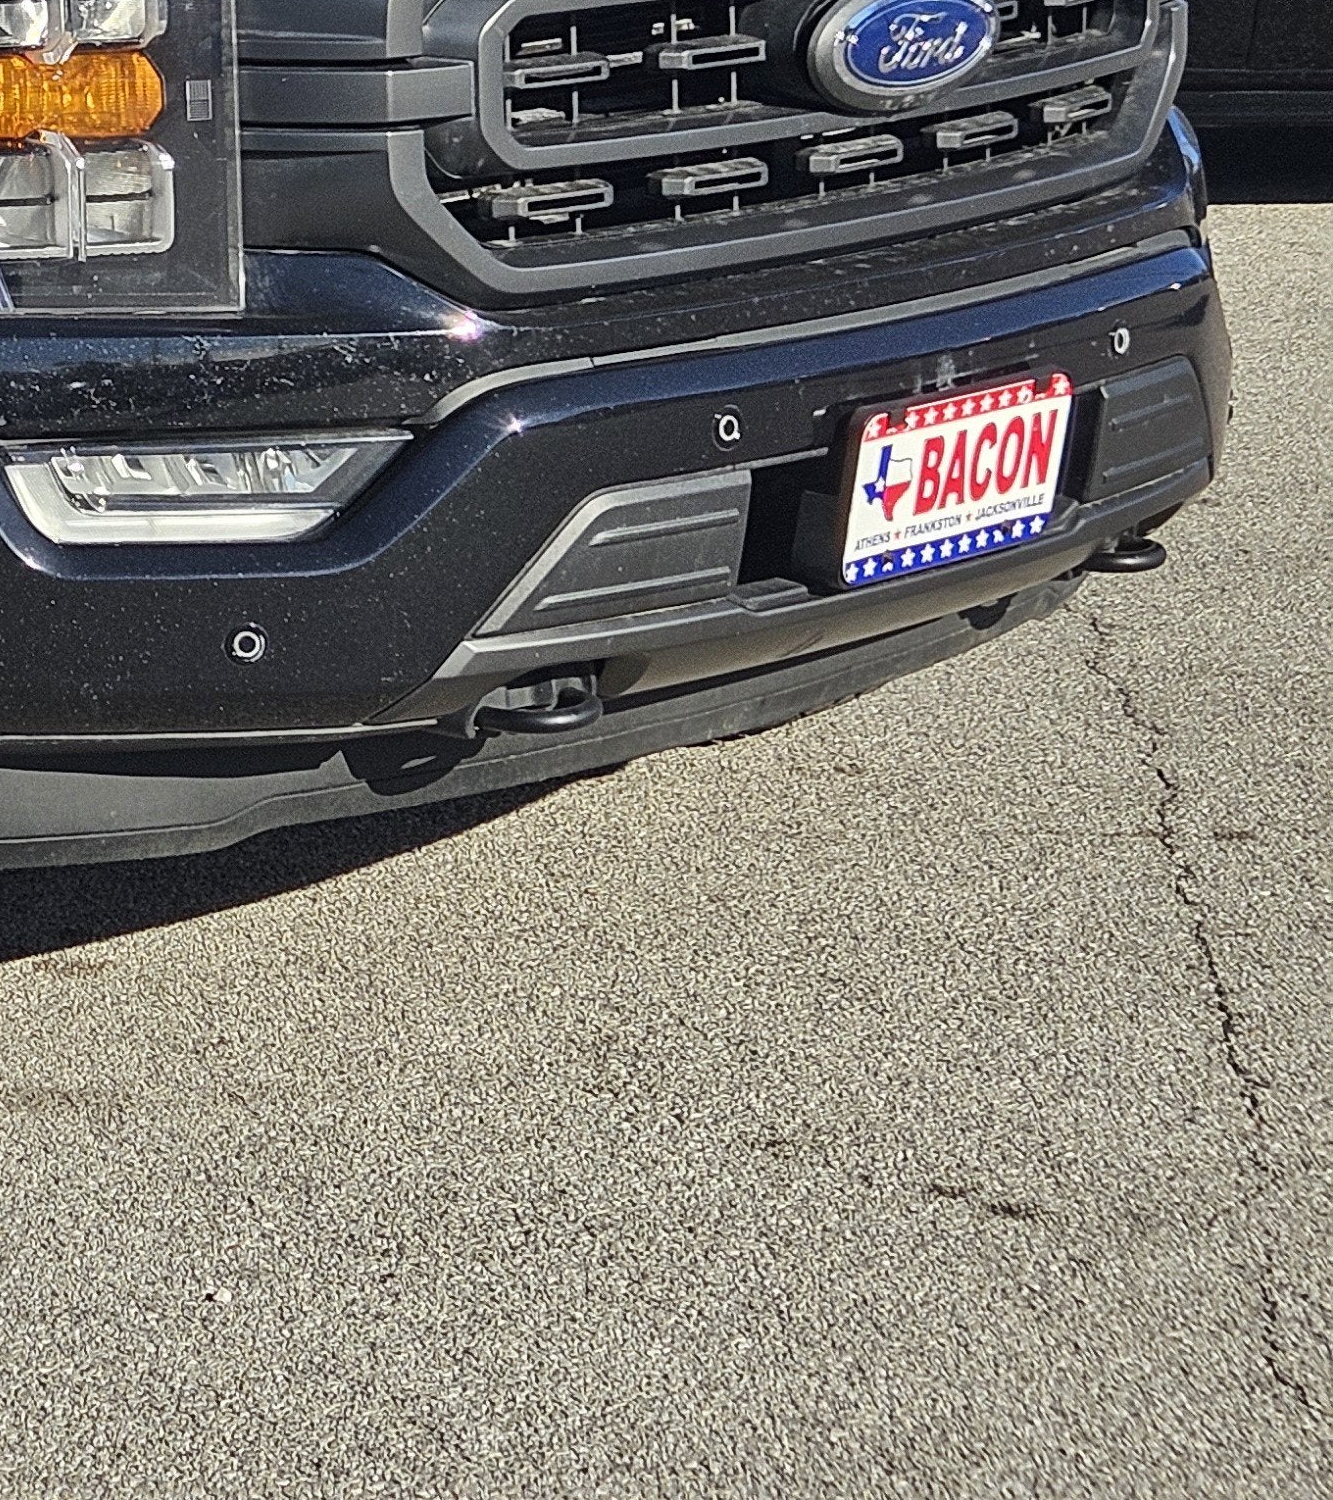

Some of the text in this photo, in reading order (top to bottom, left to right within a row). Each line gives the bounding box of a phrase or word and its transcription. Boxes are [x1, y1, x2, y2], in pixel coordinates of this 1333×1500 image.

[878, 11, 968, 74] Ford
[913, 409, 1059, 517] BACON
[854, 493, 1045, 551] ATHENS FRANKSTON JACKSONVILLE
